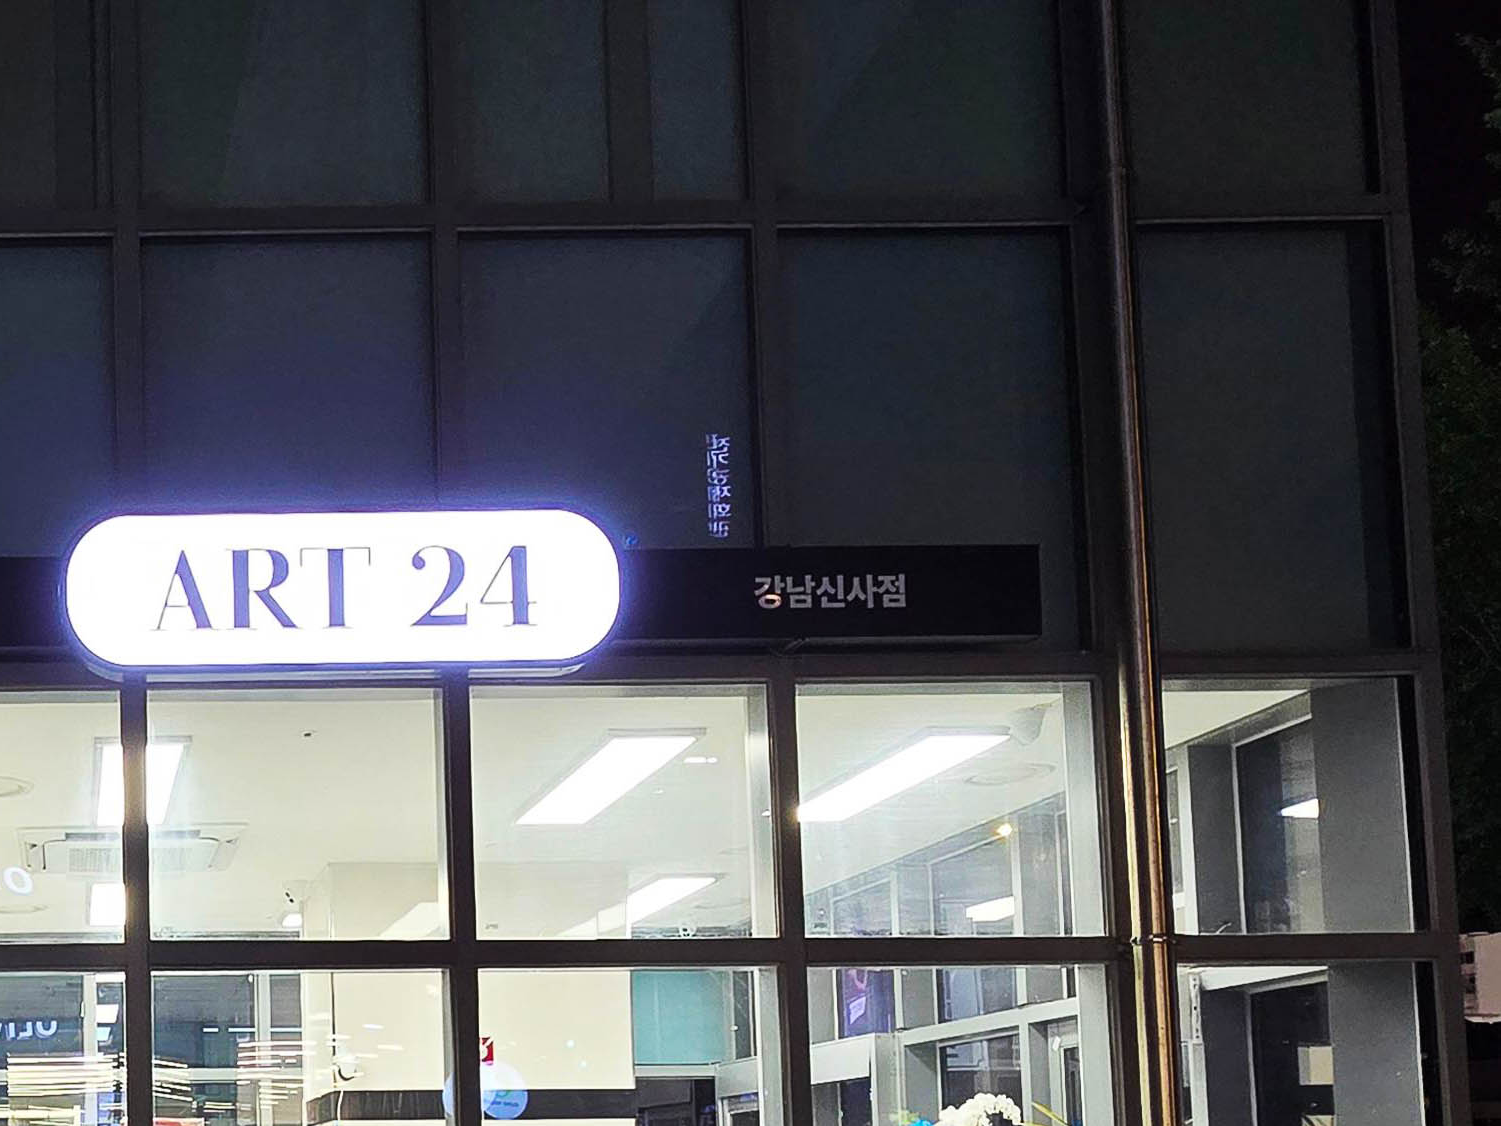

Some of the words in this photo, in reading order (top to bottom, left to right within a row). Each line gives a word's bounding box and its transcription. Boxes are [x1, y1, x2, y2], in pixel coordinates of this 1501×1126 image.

[154, 546, 372, 632] ART
[410, 544, 539, 630] 24
[753, 573, 907, 610] 강남신사점
